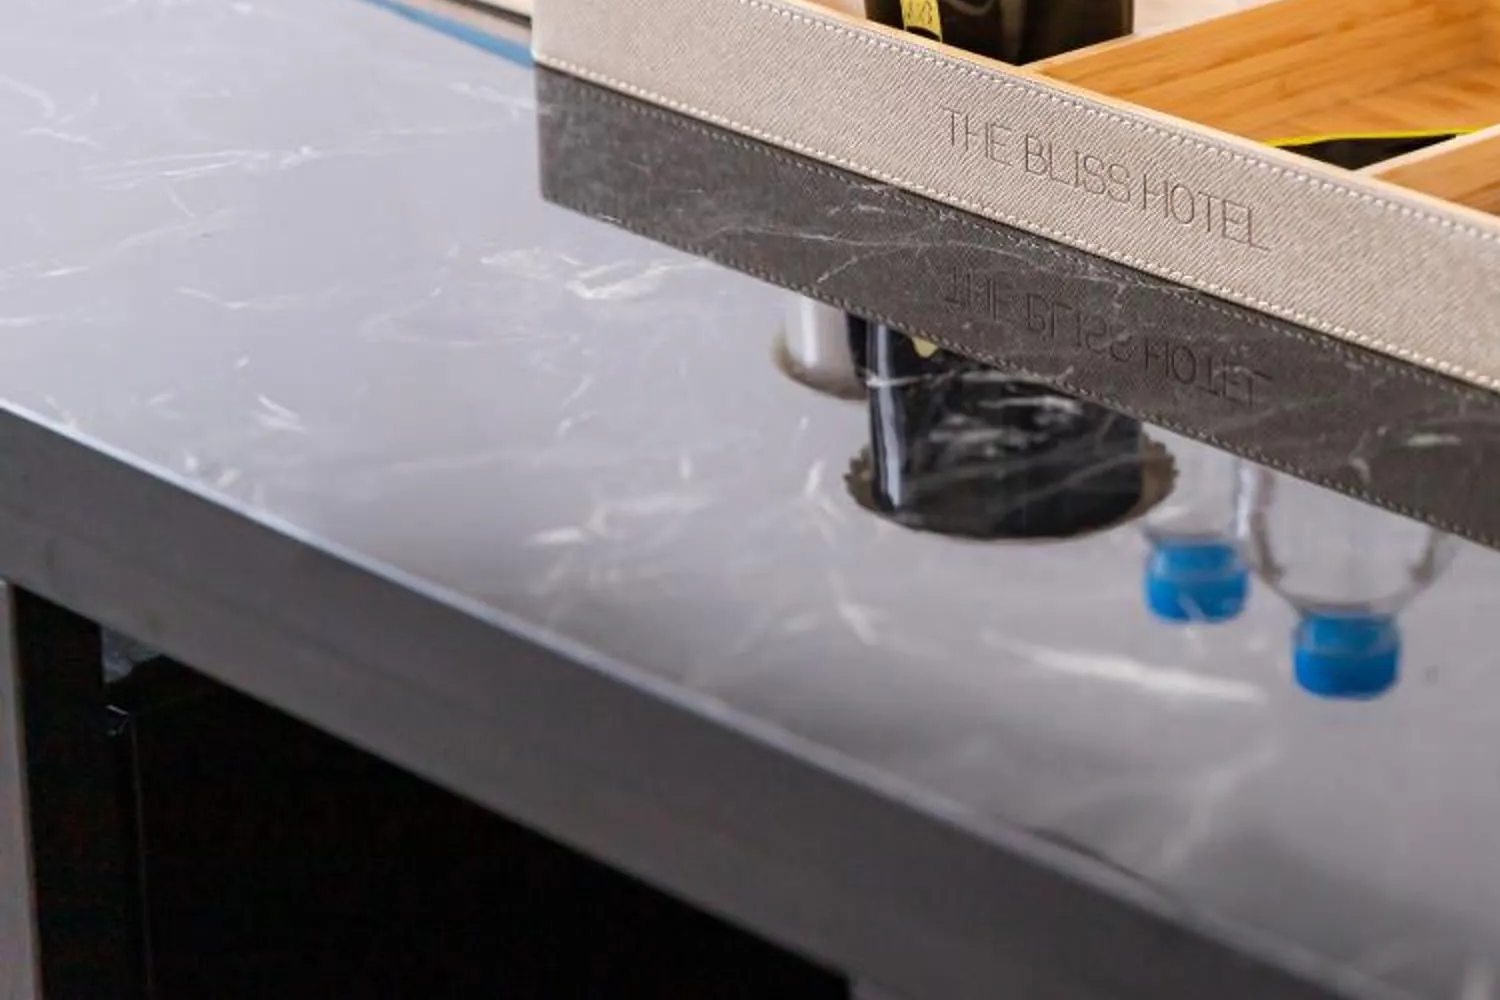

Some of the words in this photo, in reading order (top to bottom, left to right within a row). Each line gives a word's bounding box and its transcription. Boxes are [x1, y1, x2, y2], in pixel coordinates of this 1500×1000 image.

[941, 107, 1013, 167] THE
[1025, 133, 1132, 203] BLISS
[1142, 172, 1271, 252] HOTEL
